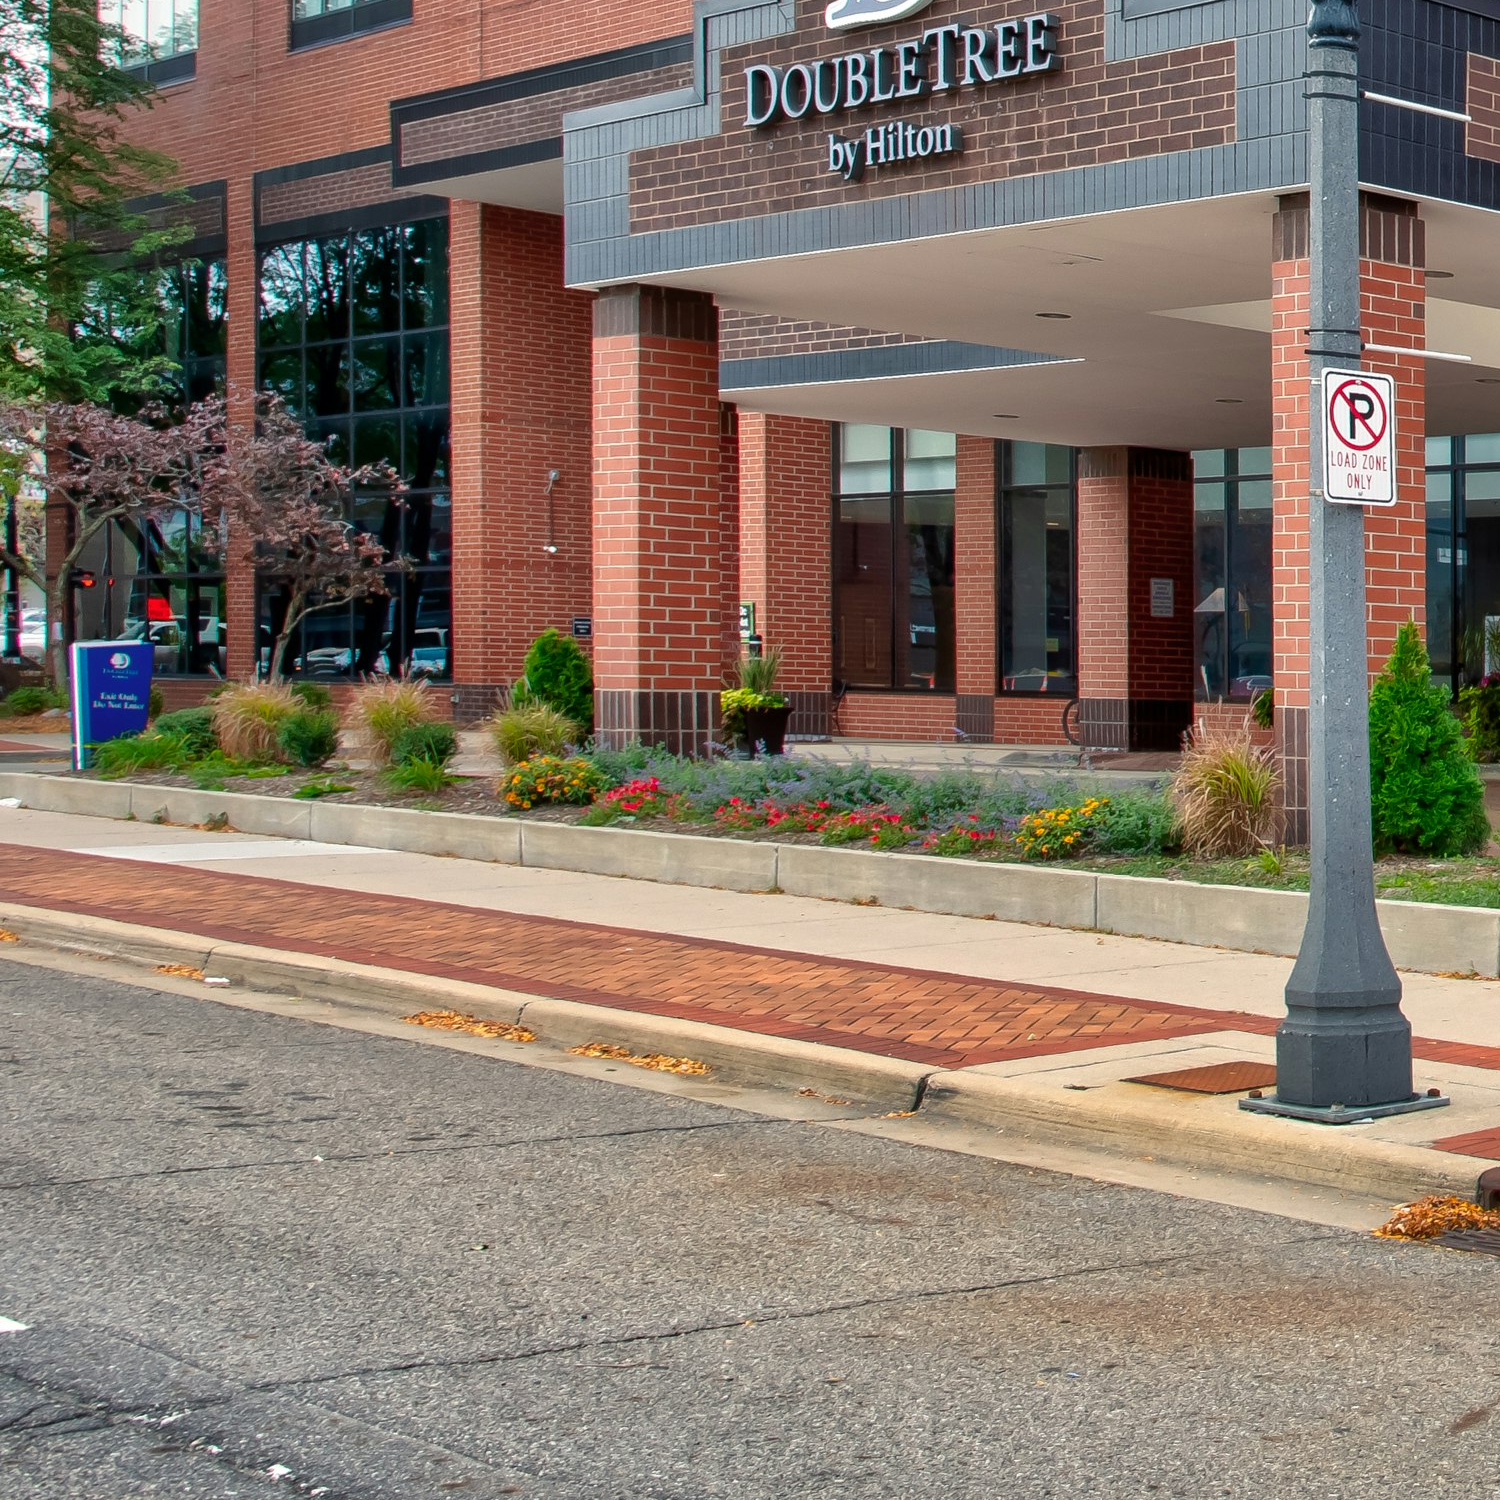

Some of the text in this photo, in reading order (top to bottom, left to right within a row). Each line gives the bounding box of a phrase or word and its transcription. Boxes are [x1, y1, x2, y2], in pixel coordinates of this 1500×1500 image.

[743, 13, 1057, 128] DOUBLETREE
[828, 120, 956, 180] by Hilton
[1330, 450, 1387, 472] LOAD ZONE
[1347, 473, 1372, 490] ONLY
[107, 701, 122, 709] Not
